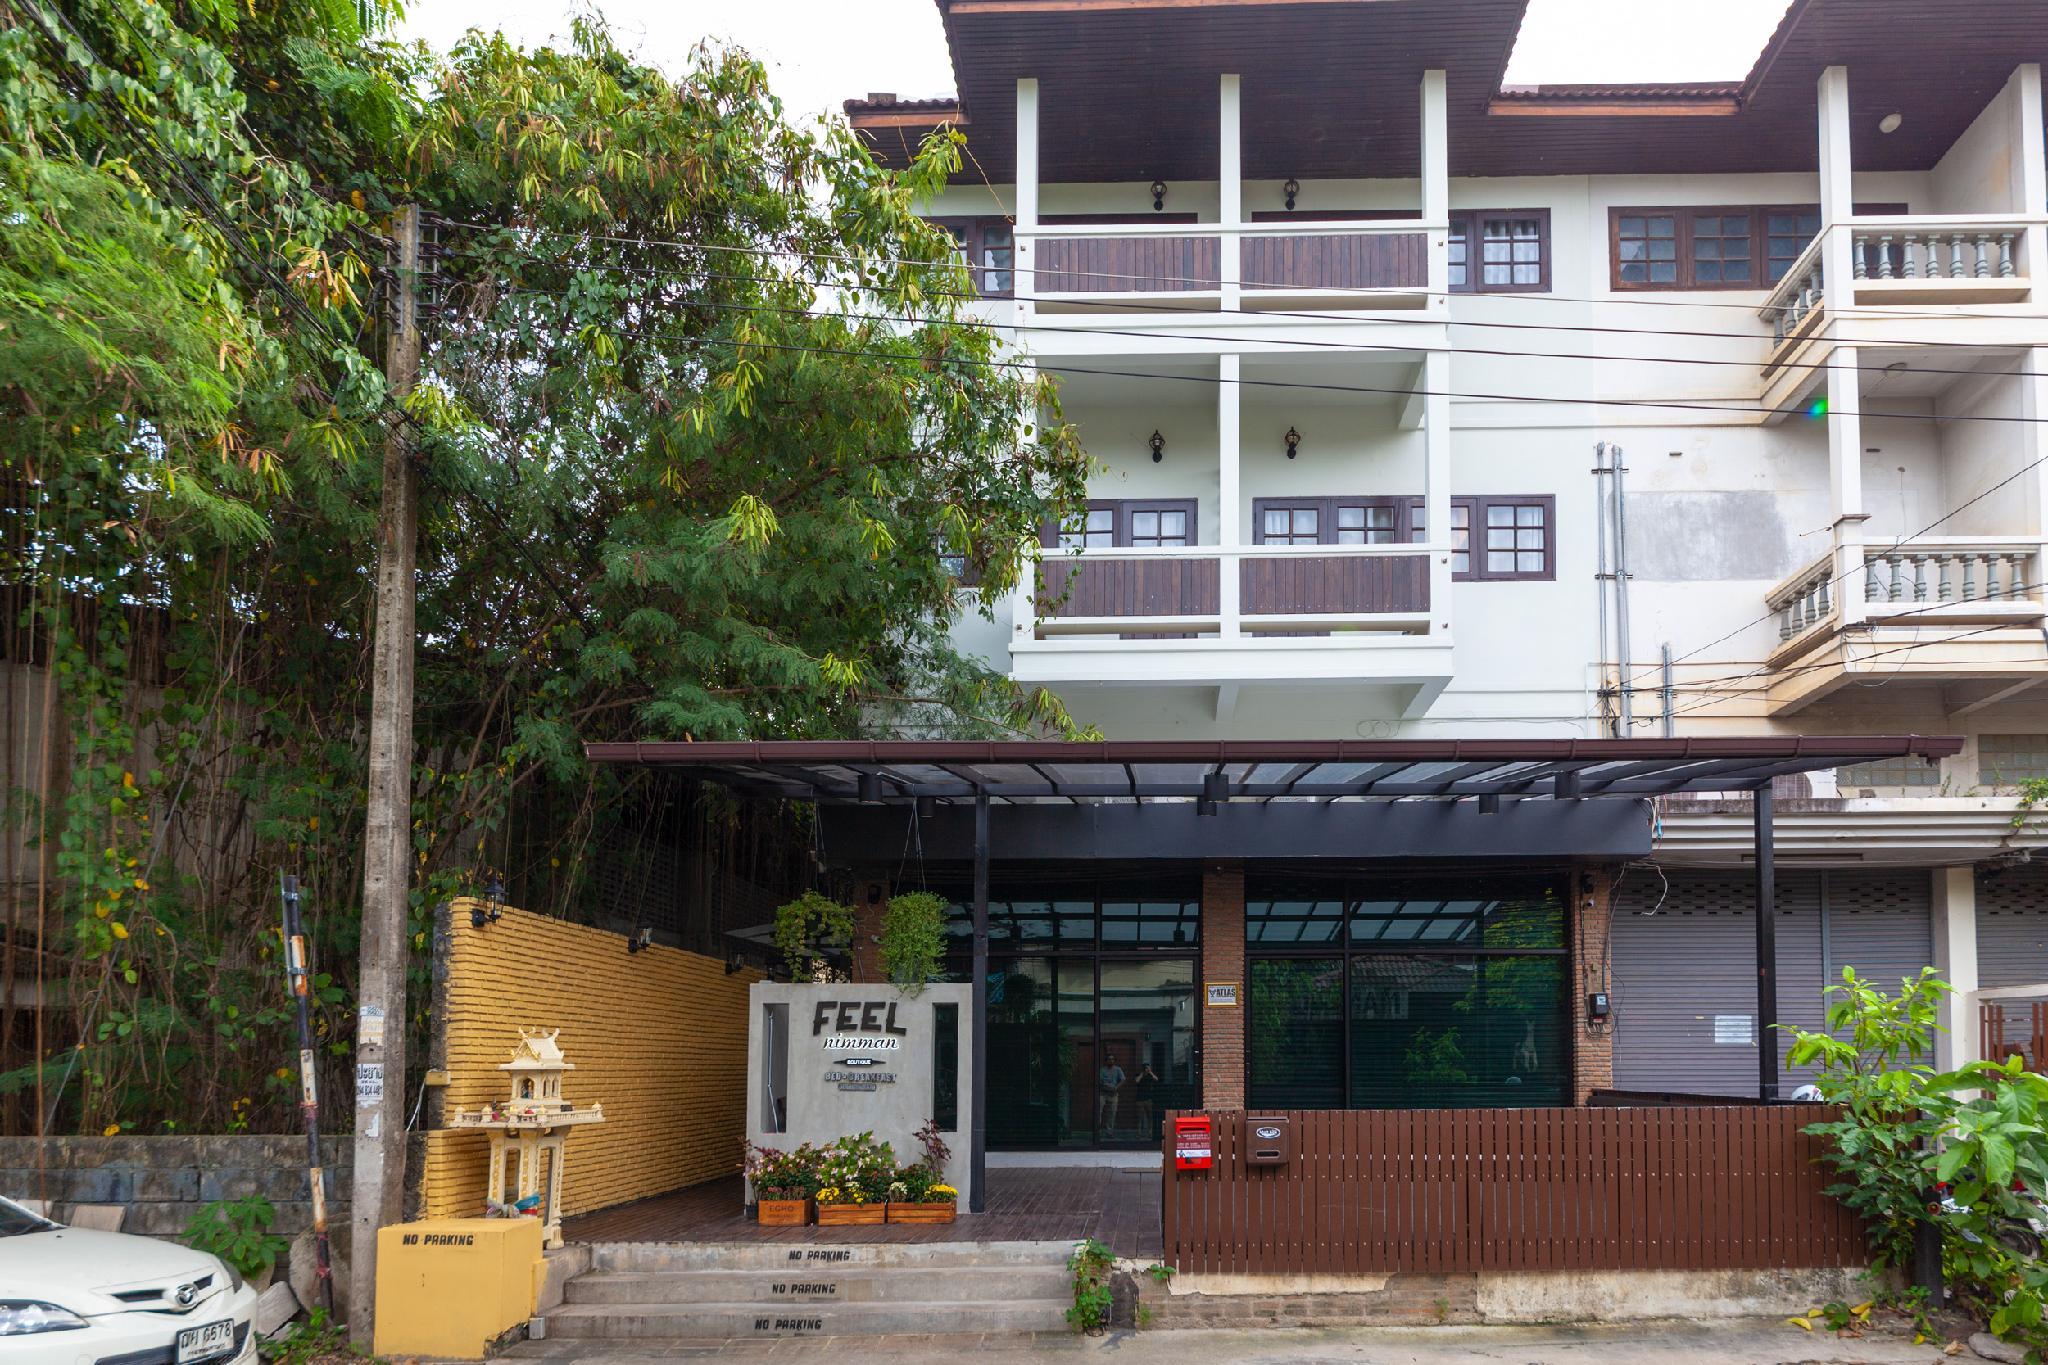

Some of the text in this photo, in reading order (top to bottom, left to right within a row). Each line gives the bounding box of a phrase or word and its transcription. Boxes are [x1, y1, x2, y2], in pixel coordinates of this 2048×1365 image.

[812, 1001, 907, 1036] FEEL
[823, 1032, 900, 1050] nimman
[825, 1072, 841, 1081] BED
[848, 1072, 898, 1083] BREAKFAST
[403, 1233, 474, 1246] NO PARKING
[789, 1250, 851, 1262] NO PARKING
[772, 1284, 836, 1294] NO PARKING
[755, 1319, 823, 1331] NO PARKING
[203, 1322, 232, 1342] 6578
